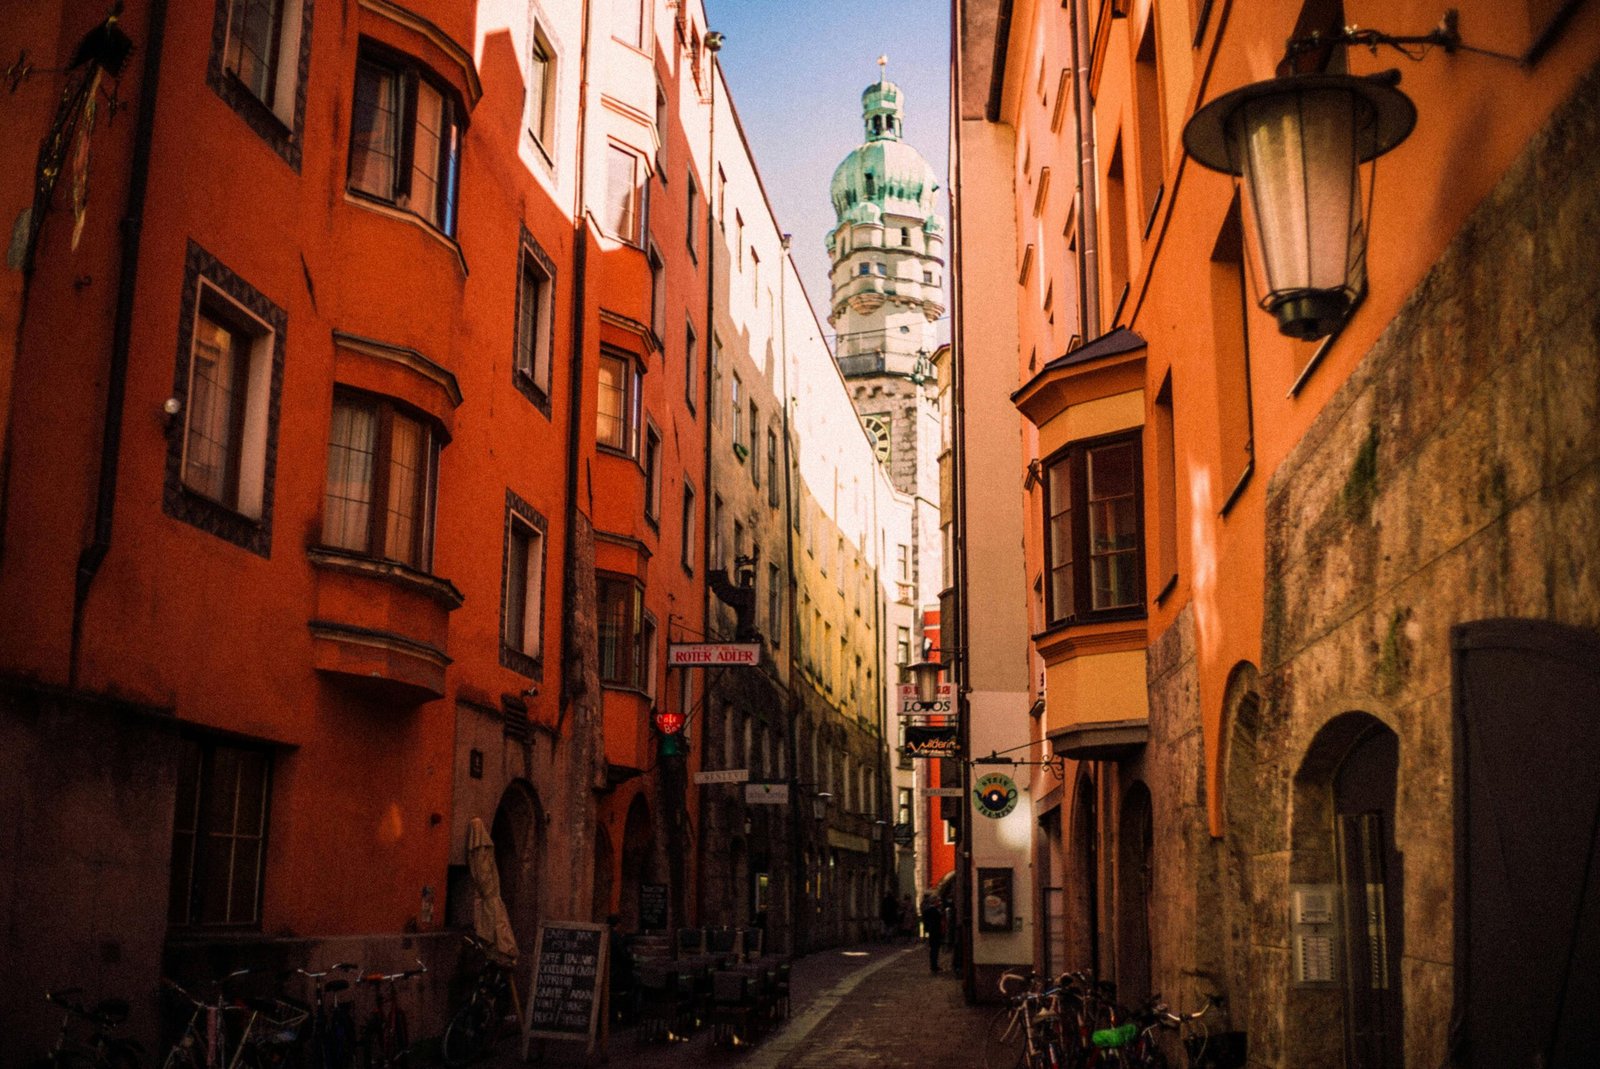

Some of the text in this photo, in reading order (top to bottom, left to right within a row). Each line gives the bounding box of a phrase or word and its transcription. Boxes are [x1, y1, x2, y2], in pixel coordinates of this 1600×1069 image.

[676, 651, 753, 662] ROTER ADLER
[981, 776, 1010, 787] STEIN
